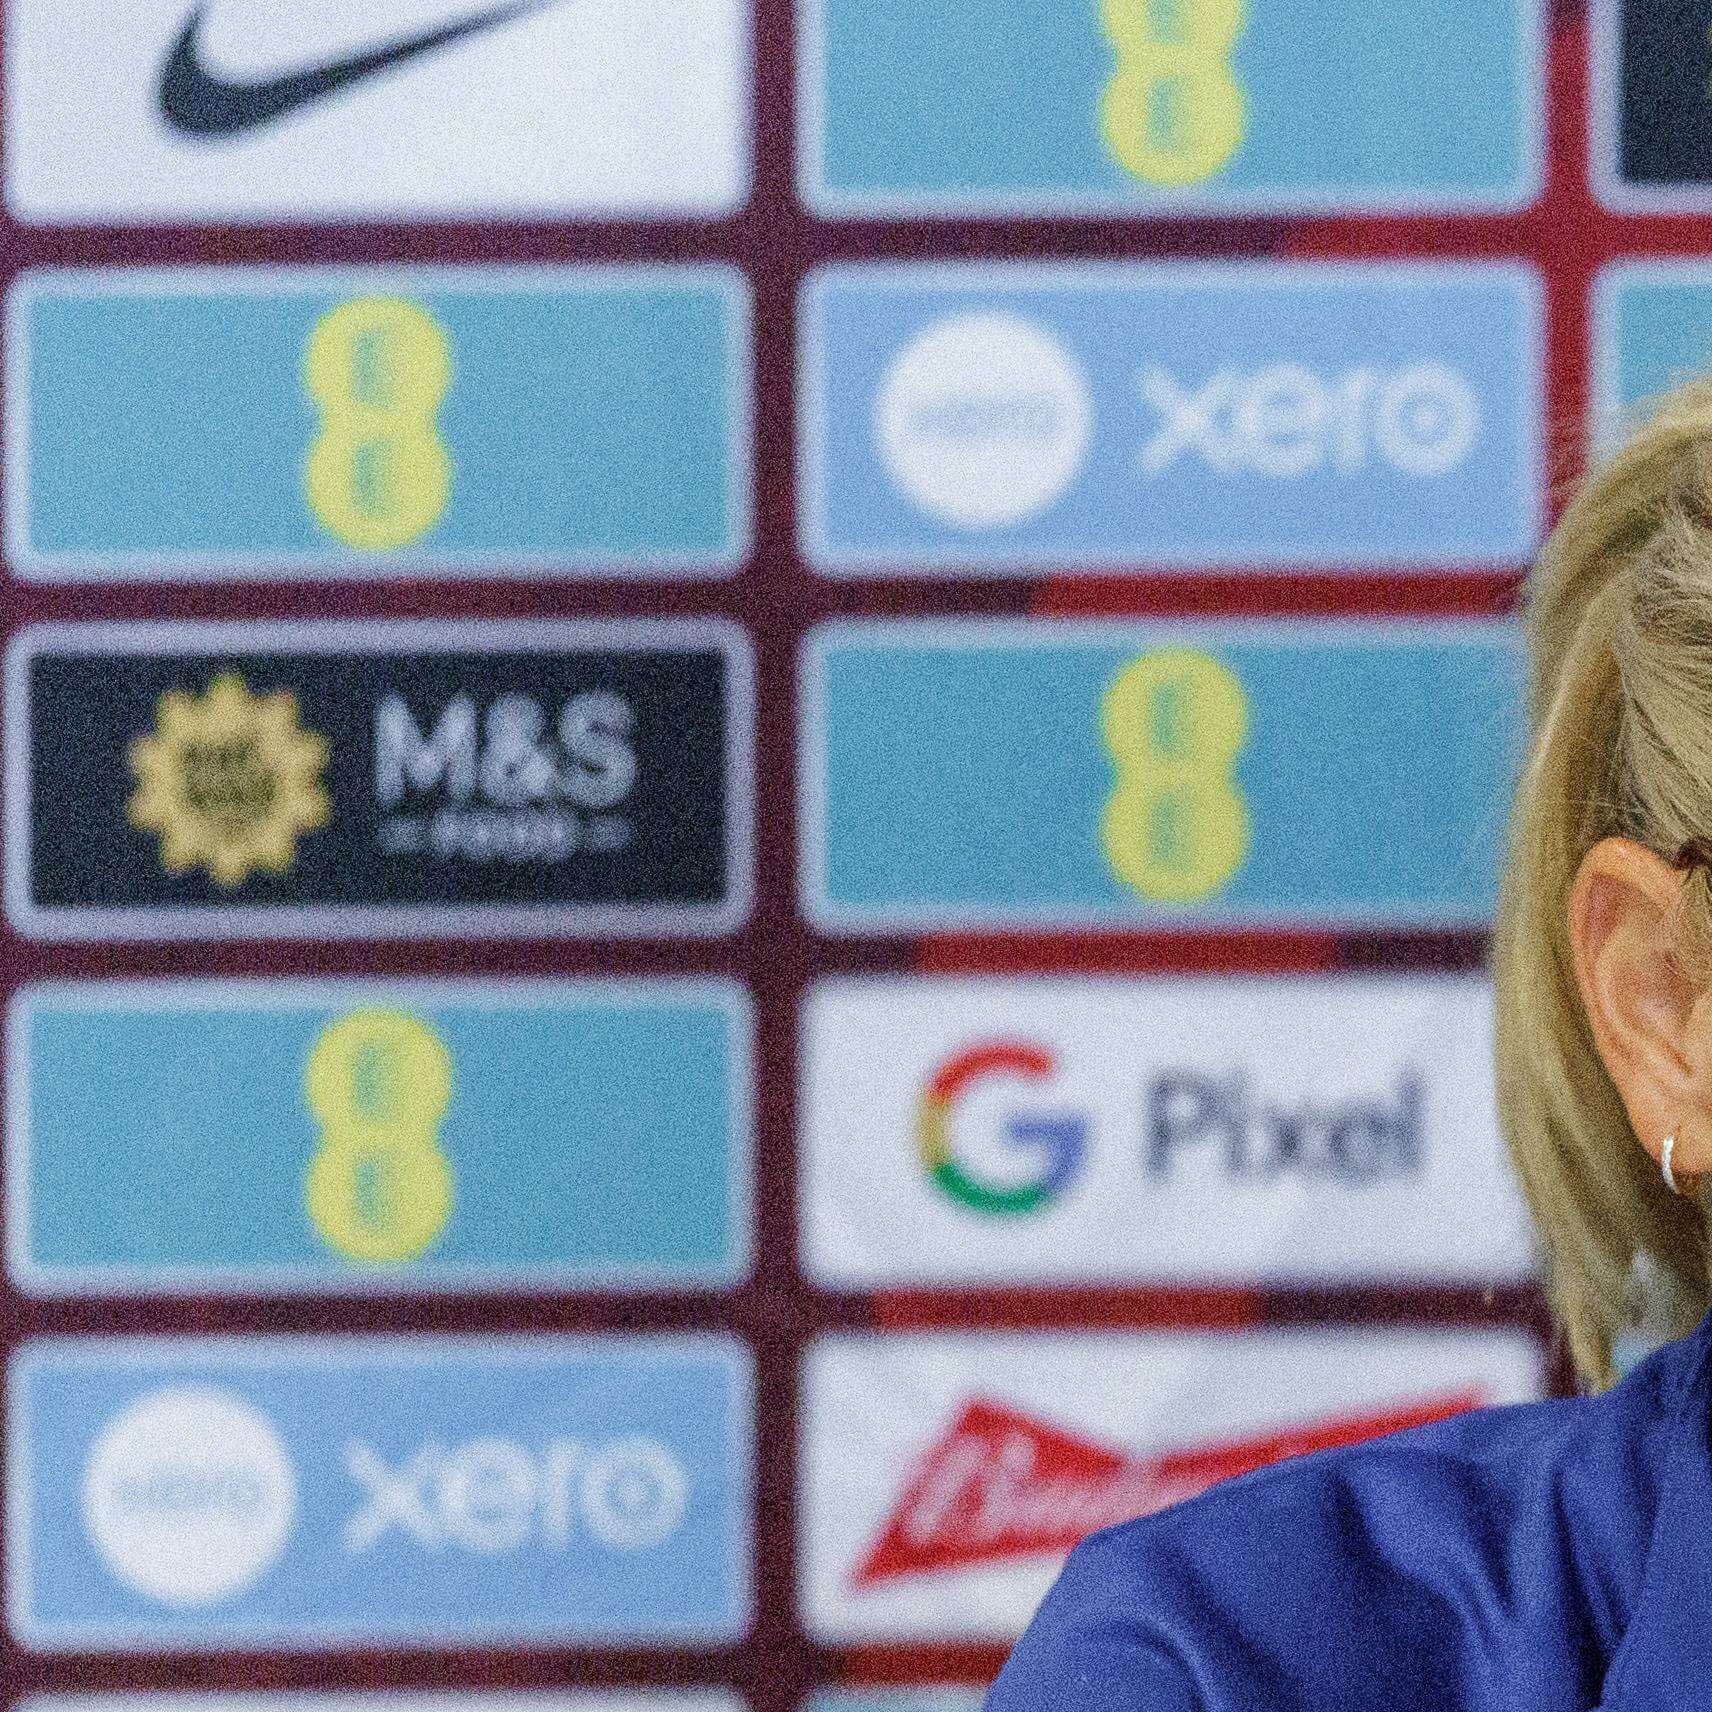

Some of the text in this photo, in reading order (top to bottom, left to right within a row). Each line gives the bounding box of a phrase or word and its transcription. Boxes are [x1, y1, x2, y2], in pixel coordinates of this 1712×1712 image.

[1139, 359, 1481, 477] xero
[374, 692, 637, 808] M&S
[1145, 1072, 1425, 1186] Pixel
[345, 1437, 689, 1553] xero
